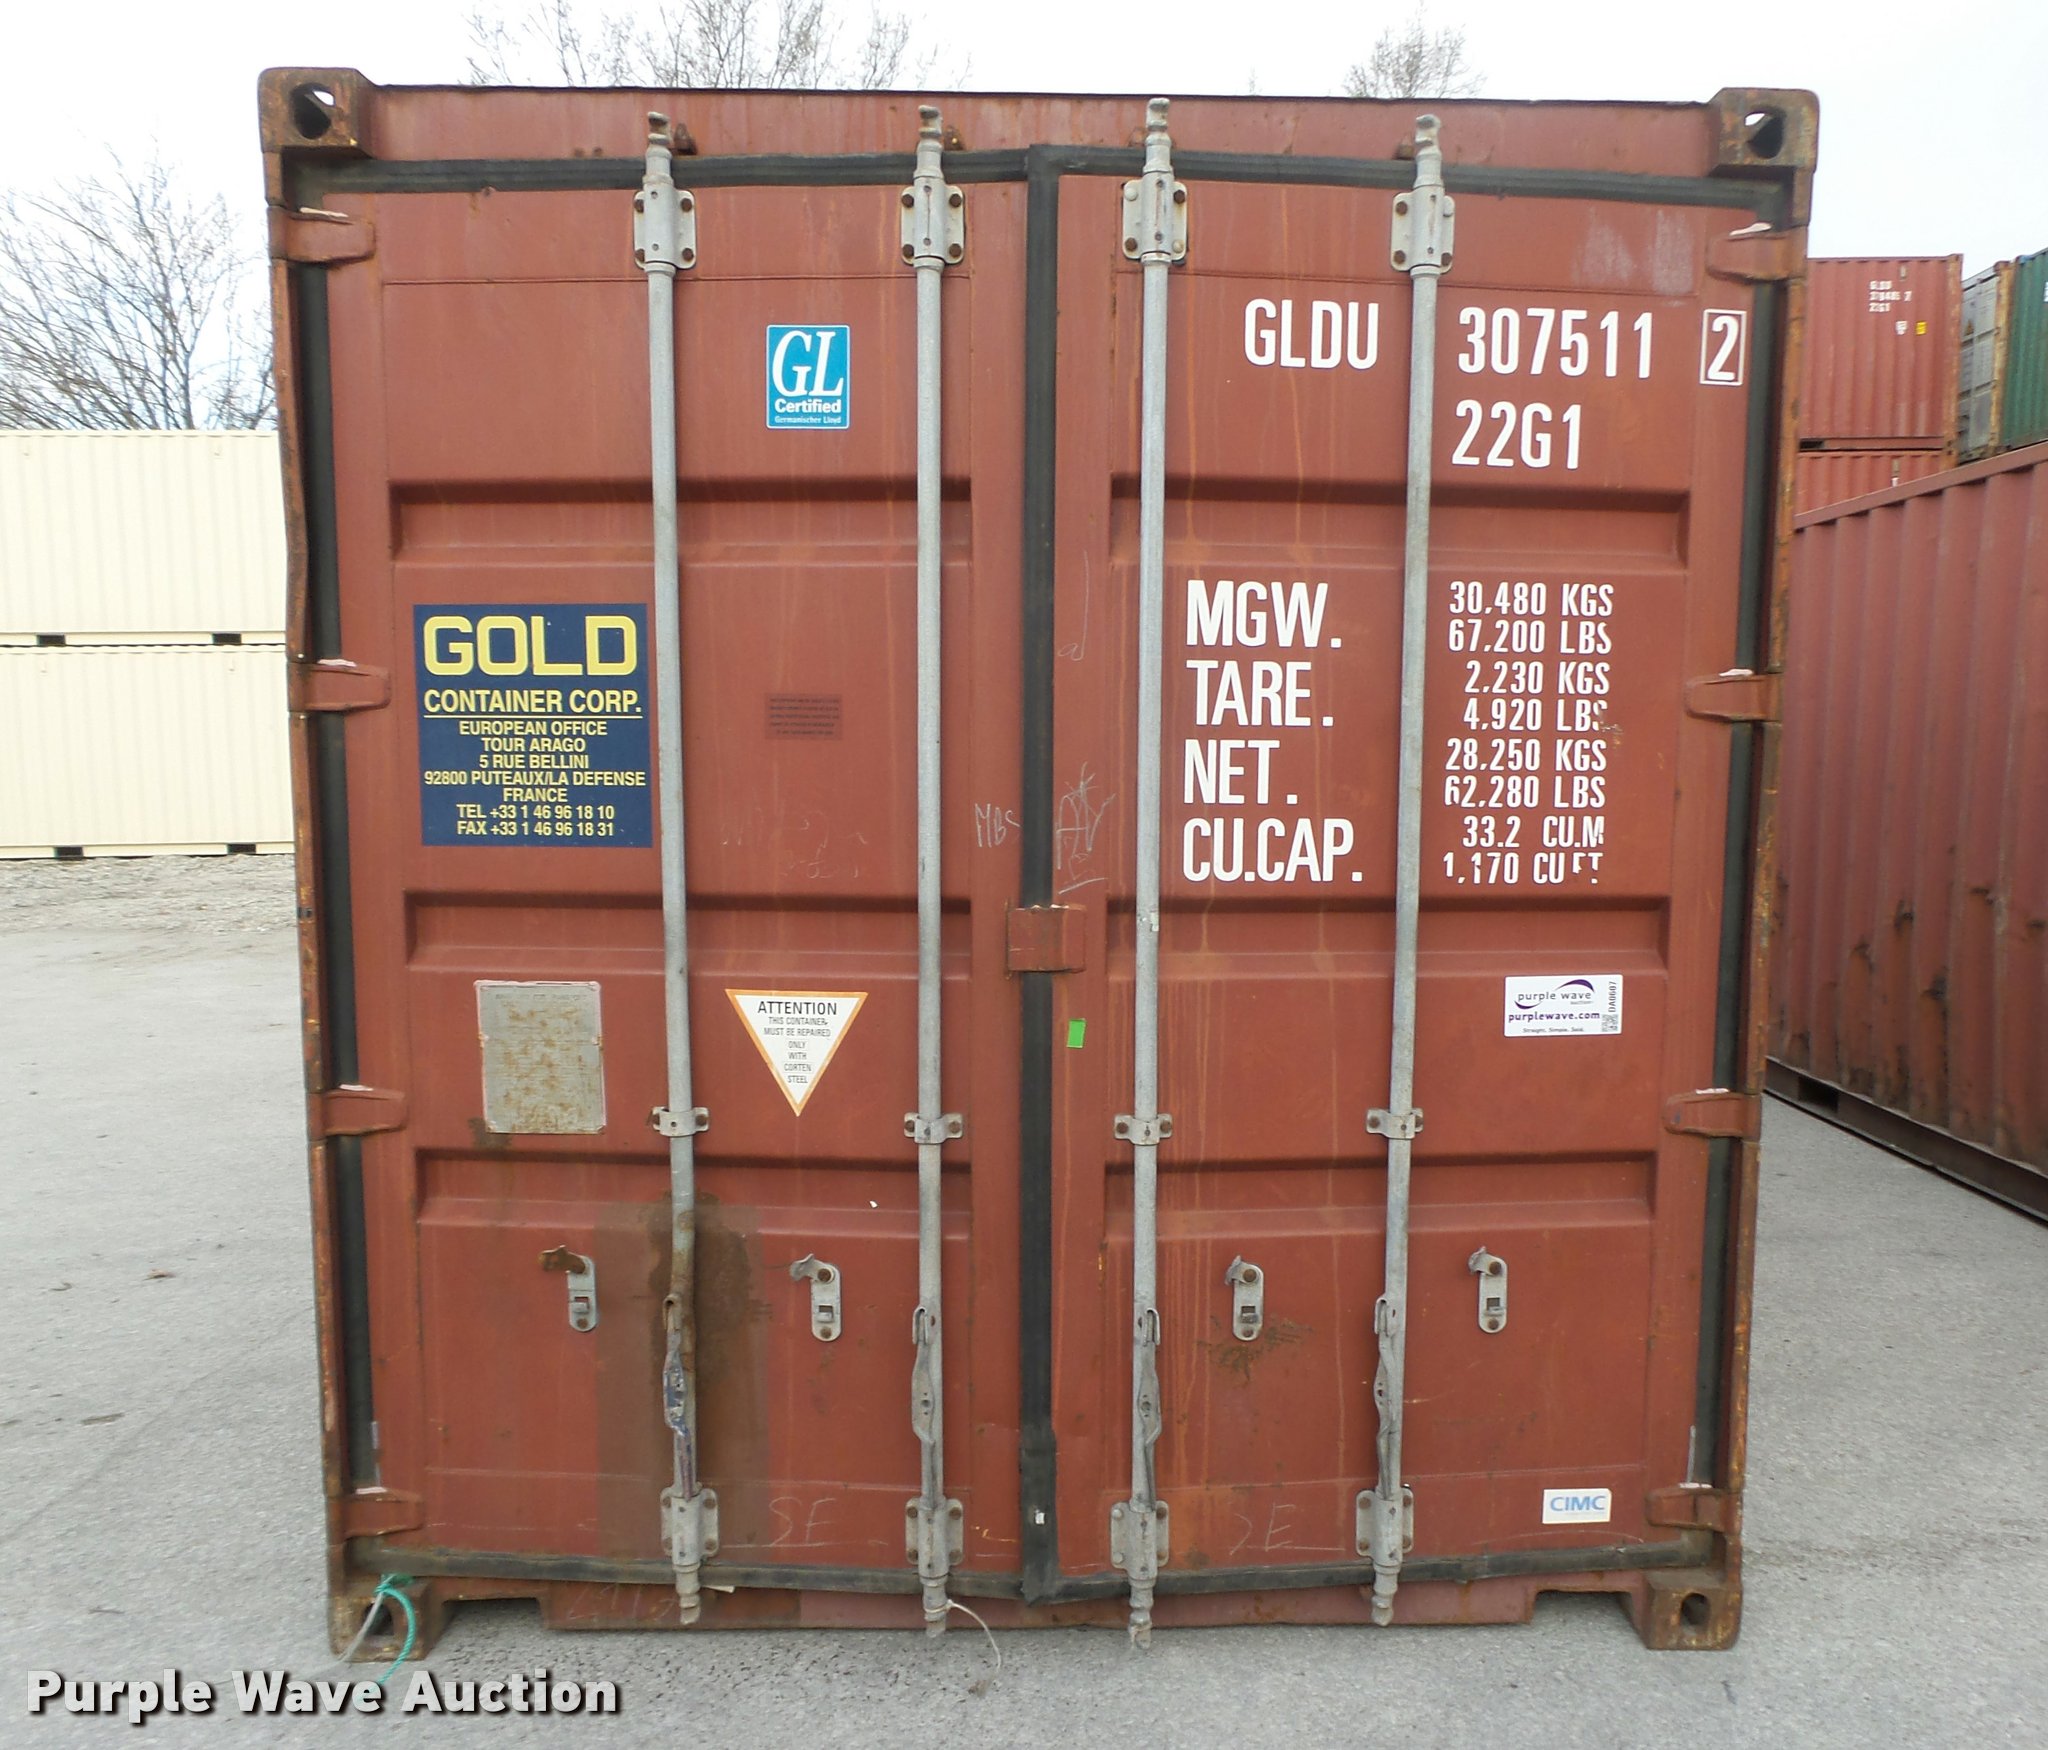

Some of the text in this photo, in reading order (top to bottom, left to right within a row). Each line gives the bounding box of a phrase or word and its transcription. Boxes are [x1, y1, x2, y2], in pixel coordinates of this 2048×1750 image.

[1245, 298, 1740, 380] GLDU 3075511 2
[772, 330, 844, 397] GL
[774, 398, 842, 413] Certified
[1452, 399, 1581, 469] 22G1
[1449, 580, 1614, 617] 30,480 KGS
[1186, 580, 1342, 648] MGW.
[1449, 618, 1612, 655] 67,200 LBS
[423, 615, 638, 676] GOLD
[1464, 659, 1610, 695] 2,230 KGS
[424, 689, 642, 713] CONTAINER CORP.
[1186, 660, 1334, 727] TARE.
[1463, 697, 1542, 730] 4,920
[459, 720, 608, 736] EUROPEAN OFFICE
[481, 737, 586, 752] TOUR ARAGO
[479, 754, 589, 769] 5 RUE BELLINI
[1445, 737, 1607, 771] 28,250 KGS
[424, 771, 467, 785] 92800
[573, 771, 646, 786] DEFENSE
[1184, 739, 1298, 805] NET.
[503, 787, 568, 802] FRANCE
[1444, 774, 1606, 808] 62,280 LBS
[456, 804, 615, 819] TEL +33 1 46 96 18 10
[457, 821, 614, 836] FAX +33 1 46 96 18 31
[1462, 815, 1605, 848] 33.2 CU.M
[1183, 817, 1363, 882] CU.CAP.
[1443, 852, 1519, 885] 1,170
[1518, 991, 1592, 1001] purple wave
[757, 1001, 838, 1016] ATTENTION
[768, 1016, 784, 1025] THIS
[1508, 1011, 1600, 1023] purplewave.com
[764, 1027, 831, 1037] MUST BE REPAIRED
[788, 1040, 806, 1049] ONLY
[788, 1051, 807, 1060] WITH
[784, 1063, 811, 1072] CORTEN
[788, 1075, 808, 1084] STEEL
[1550, 1495, 1606, 1511] CIMC
